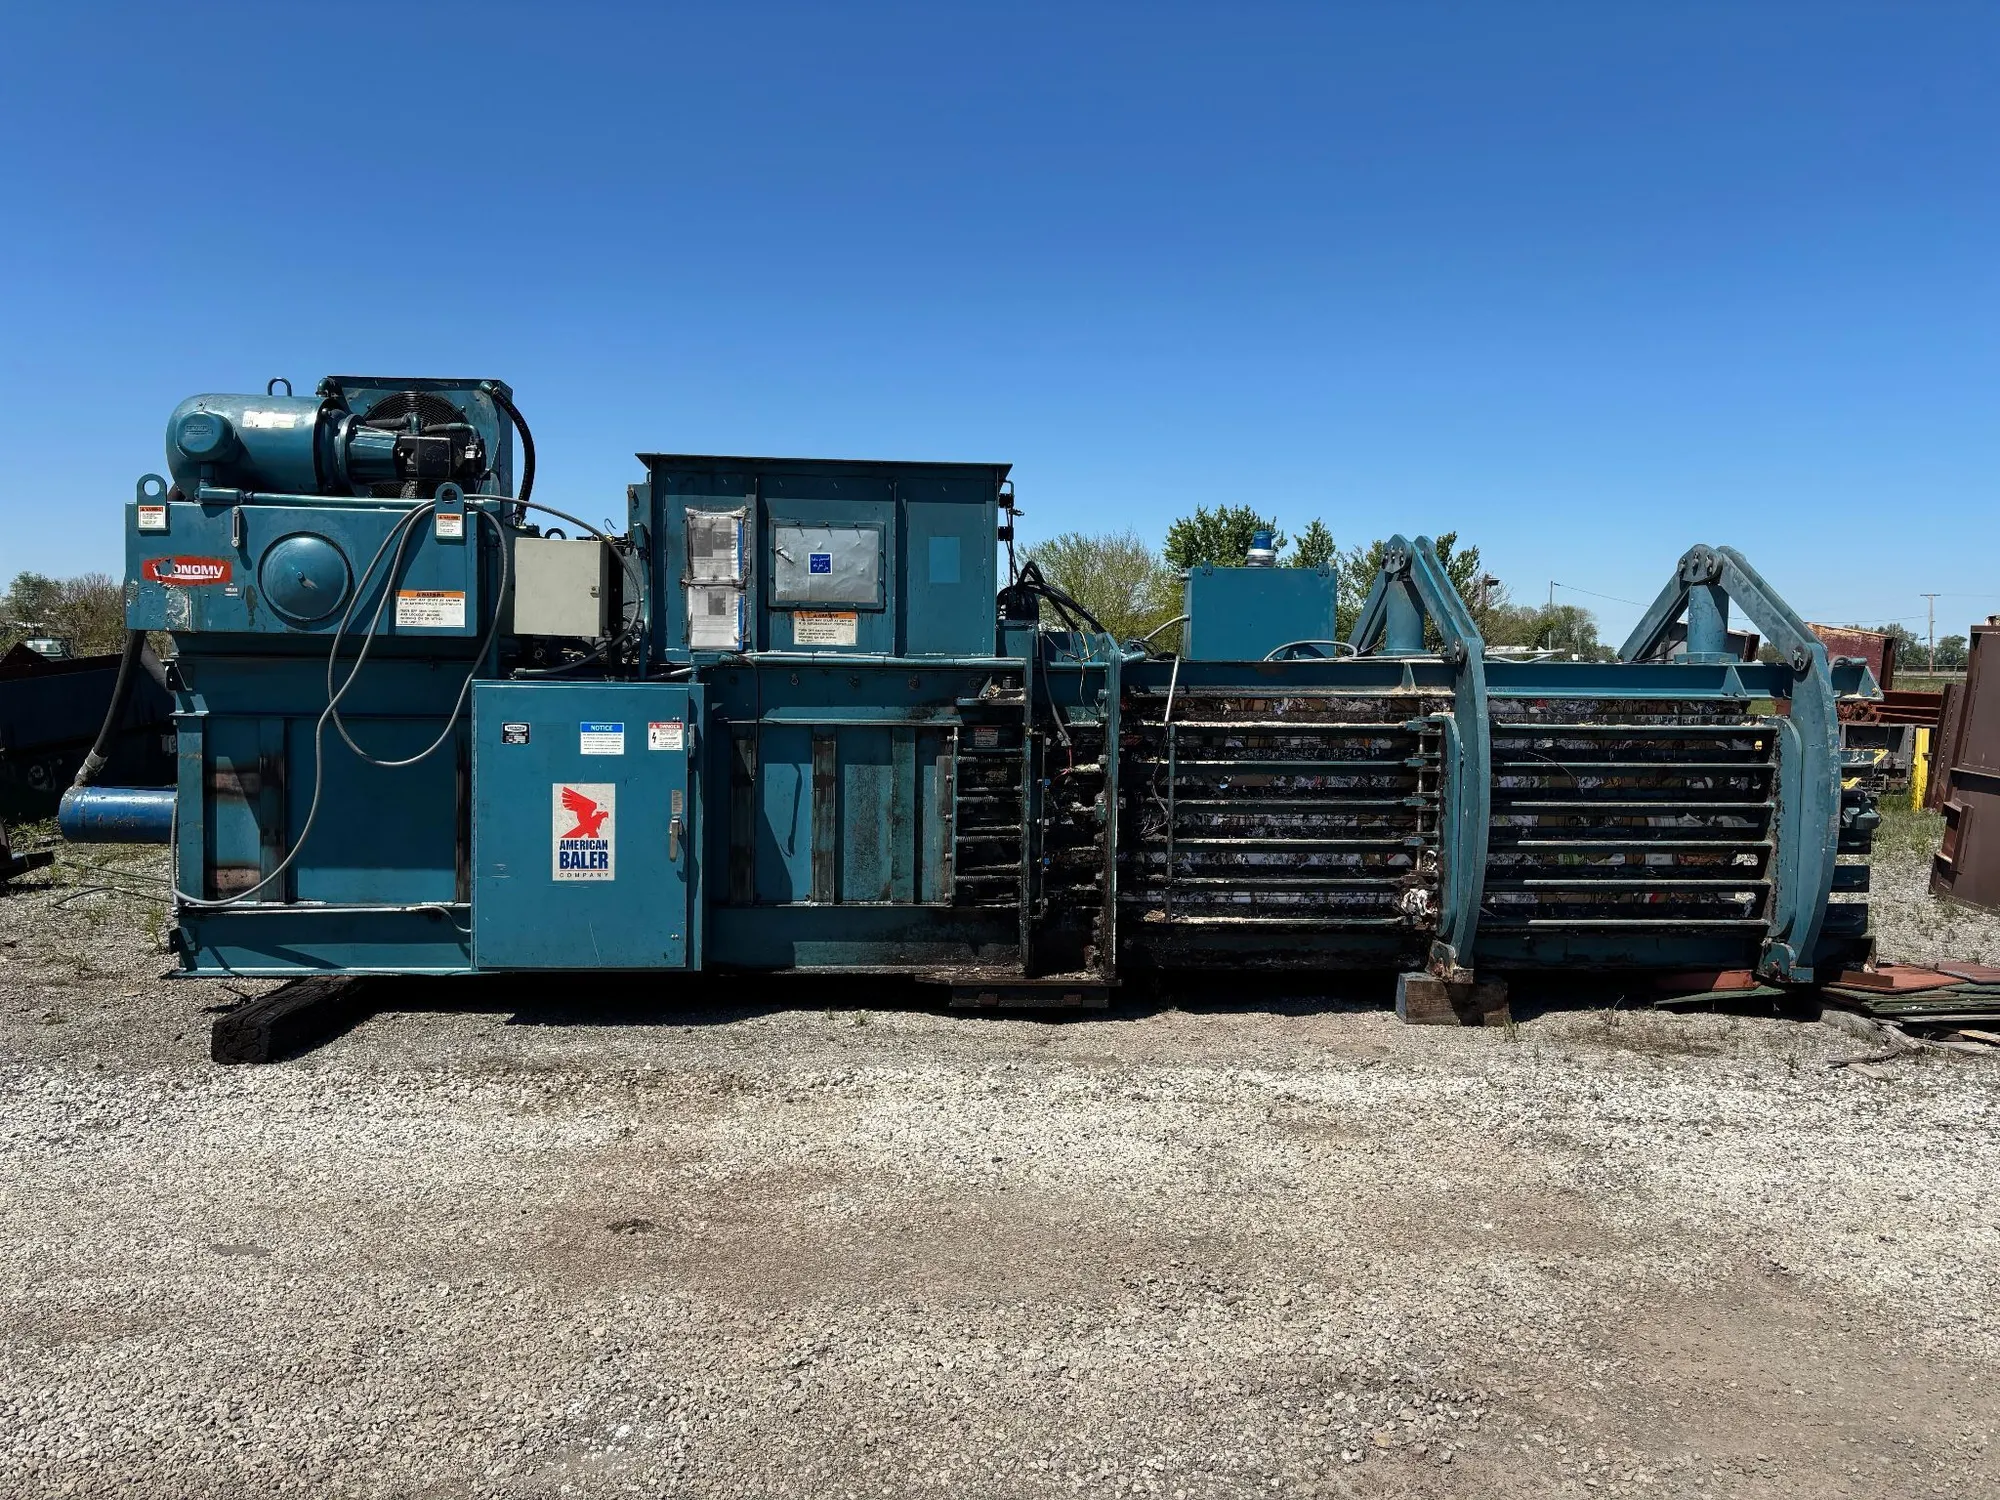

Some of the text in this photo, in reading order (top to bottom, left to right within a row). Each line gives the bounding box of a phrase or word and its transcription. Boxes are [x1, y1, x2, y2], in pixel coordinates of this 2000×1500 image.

[152, 563, 224, 579] ONOMY
[590, 724, 614, 732] NOTICE
[559, 839, 608, 851] AMERICAN
[559, 851, 609, 870] BALER
